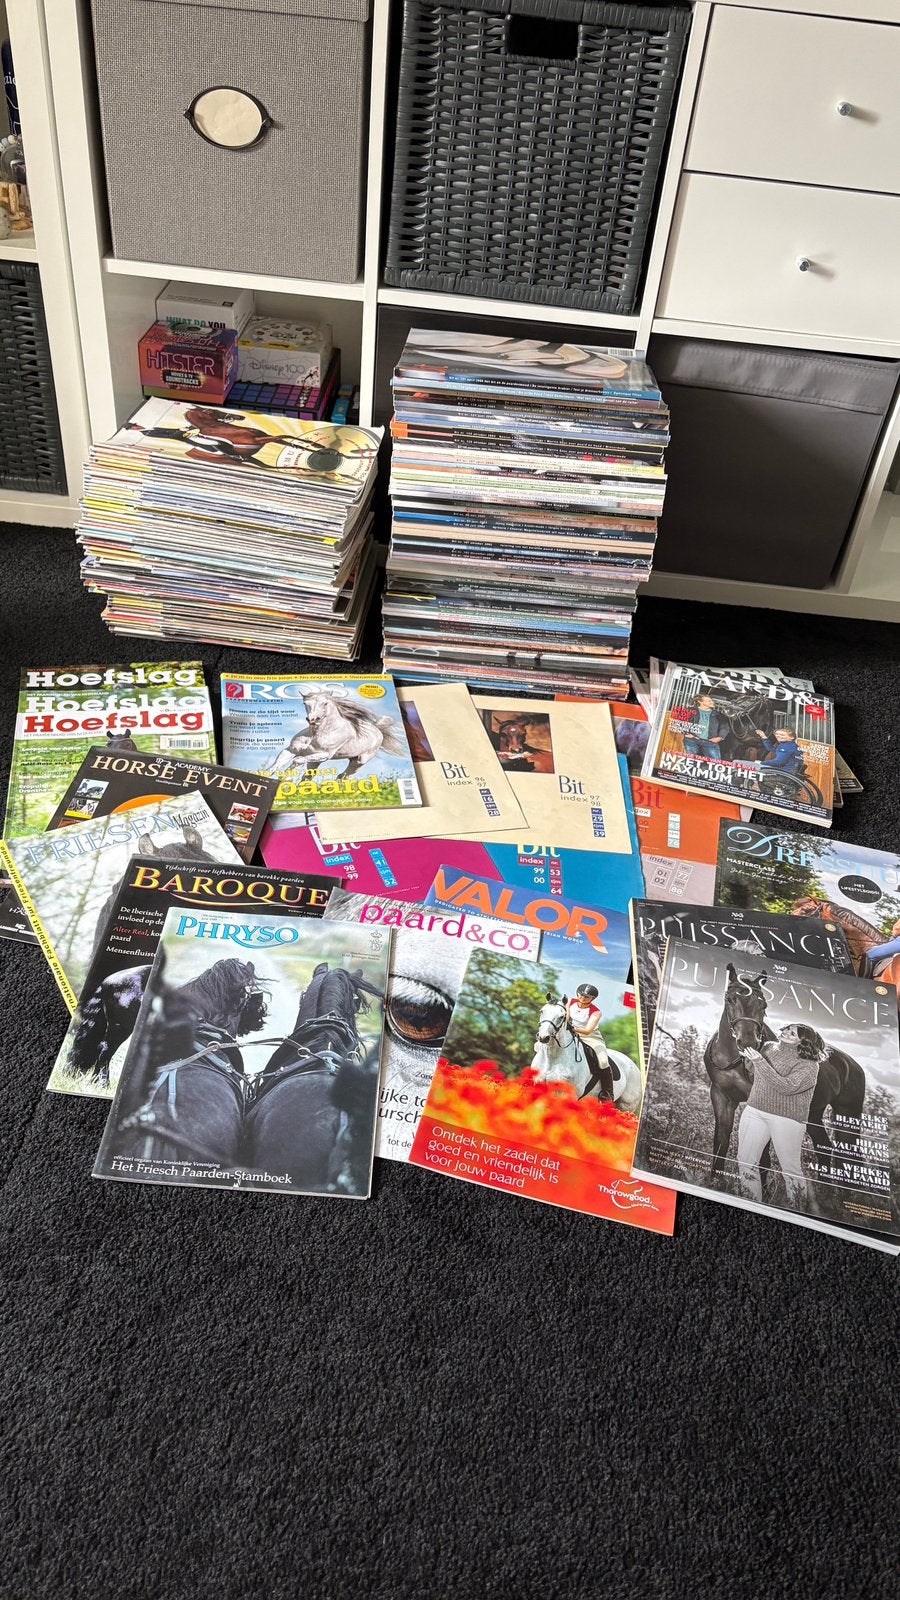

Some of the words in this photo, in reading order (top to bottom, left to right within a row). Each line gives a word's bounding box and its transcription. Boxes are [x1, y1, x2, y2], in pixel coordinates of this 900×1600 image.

[208, 321, 226, 329] YOU
[147, 349, 215, 376] HITSTER
[251, 359, 285, 376] Disney
[285, 363, 305, 374] 100
[165, 375, 199, 386] SOUNDTRACKS
[26, 668, 197, 687] Hoefslag
[243, 682, 349, 700] ROS
[25, 693, 207, 713] Hoefslag
[24, 711, 204, 733] Hoefslag
[175, 762, 208, 773] ACADEMY
[305, 767, 337, 776] met
[440, 761, 470, 780] Bit
[659, 761, 733, 785] MAXIMUM
[661, 751, 704, 770] INZET
[706, 761, 736, 775] TOT
[737, 768, 766, 782] HET
[91, 755, 177, 780] HORSE
[183, 769, 268, 798] EVENT
[558, 774, 586, 796] Bit
[274, 775, 382, 800] paard
[560, 795, 588, 803] index
[27, 810, 178, 868] FRIESEN
[172, 807, 210, 830] Magazin
[343, 864, 356, 872] 98
[520, 857, 544, 865] index
[649, 855, 674, 867] index
[726, 857, 776, 873] MASTERCLASS
[165, 864, 197, 873] Tijdschrift
[212, 867, 244, 877] liefhebbers
[257, 872, 280, 881] barokke
[281, 876, 305, 884] paarden
[384, 878, 397, 886] 52
[533, 876, 545, 884] 00
[654, 876, 665, 885] 02
[129, 865, 331, 908] BAROQUE
[131, 907, 164, 917] Iberische
[433, 869, 609, 954] VALOR
[434, 899, 466, 913] DEDICATED
[117, 914, 144, 923] invloed
[144, 918, 155, 926] op
[110, 934, 132, 942] paard
[112, 926, 131, 934] Alter
[176, 915, 299, 949] PHRYSO
[671, 956, 891, 1028] PUISSANCE
[835, 1114, 889, 1131] BLEYAERT
[861, 1112, 889, 1125] ELKE
[388, 1138, 399, 1146] tot
[432, 1126, 478, 1149] Ontdek
[480, 1139, 502, 1155] het
[503, 1147, 538, 1164] zadel
[540, 1157, 561, 1171] dat
[832, 1140, 890, 1159] VAUTMANS
[856, 1138, 890, 1152] HILDE
[425, 1151, 453, 1167] voor
[453, 1160, 487, 1178] jouw
[488, 1171, 526, 1189] paard
[427, 1139, 461, 1156] goed
[463, 1150, 480, 1161] en
[483, 1156, 546, 1181] vriendelijk
[549, 1172, 559, 1185] is
[842, 1162, 890, 1179] WERKEN
[111, 1160, 134, 1172] Het
[136, 1163, 178, 1177] Friesch
[182, 1167, 292, 1184] Paarden-Stamboek
[807, 1162, 828, 1173] ALS
[830, 1167, 851, 1179] EEN
[853, 1172, 891, 1187] PAARD
[598, 1184, 650, 1204] Thorowgood
